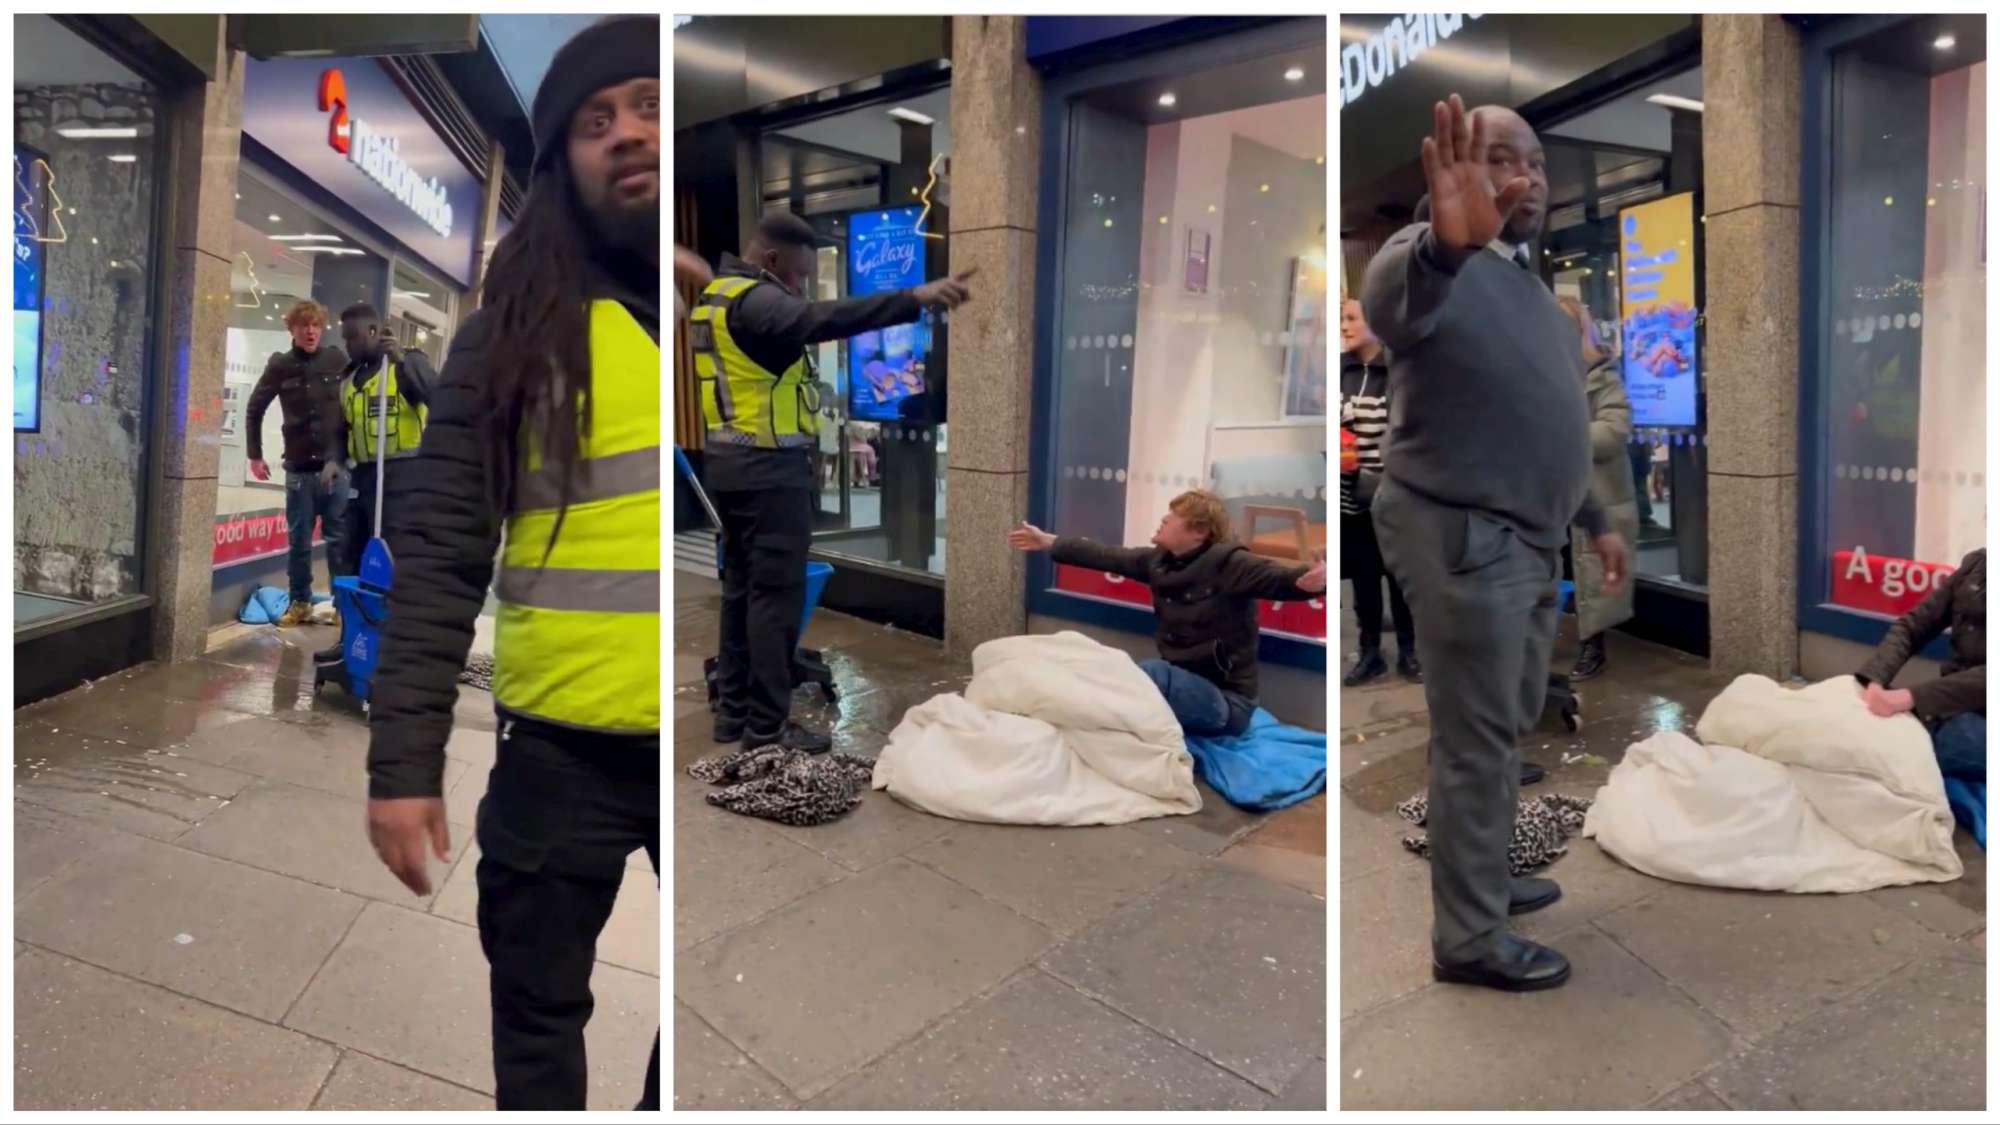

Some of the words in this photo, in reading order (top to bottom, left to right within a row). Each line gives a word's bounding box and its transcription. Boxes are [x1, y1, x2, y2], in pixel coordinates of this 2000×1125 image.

[349, 118, 453, 238] nationwide
[855, 239, 917, 277] Galaxy
[213, 515, 246, 549] ood
[248, 519, 274, 541] way
[1845, 545, 1873, 583] A
